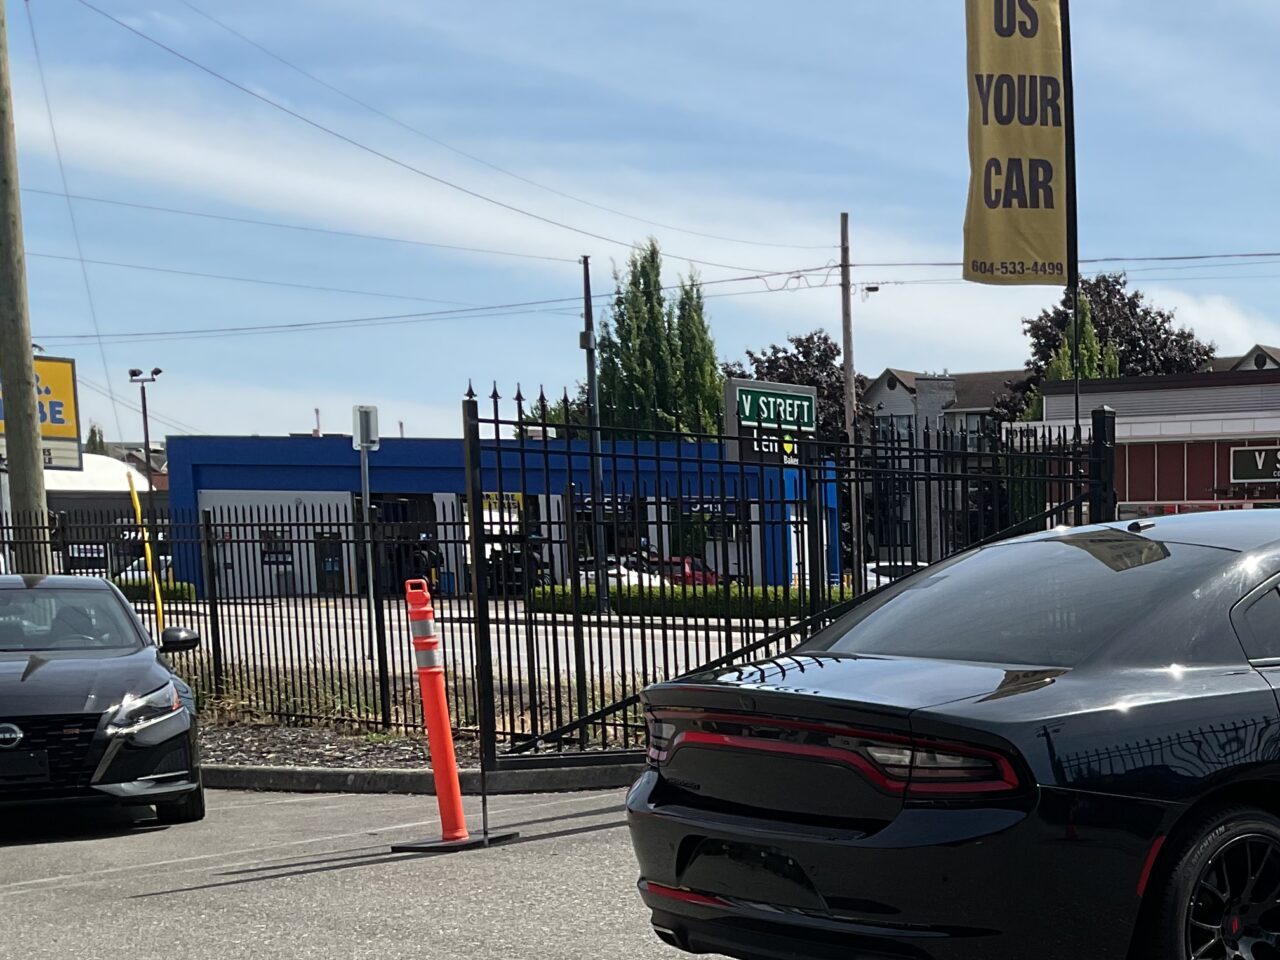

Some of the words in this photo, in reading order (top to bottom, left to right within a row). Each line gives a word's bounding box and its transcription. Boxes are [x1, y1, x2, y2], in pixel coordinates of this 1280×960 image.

[994, 0, 1039, 38] US
[975, 74, 1062, 127] YOUR
[983, 157, 1055, 210] CAR
[971, 260, 1063, 276] 604-533-4499
[742, 394, 751, 416] V
[759, 396, 809, 423] STREET
[1254, 451, 1266, 470] V
[1191, 825, 1226, 865] MICHELIN
